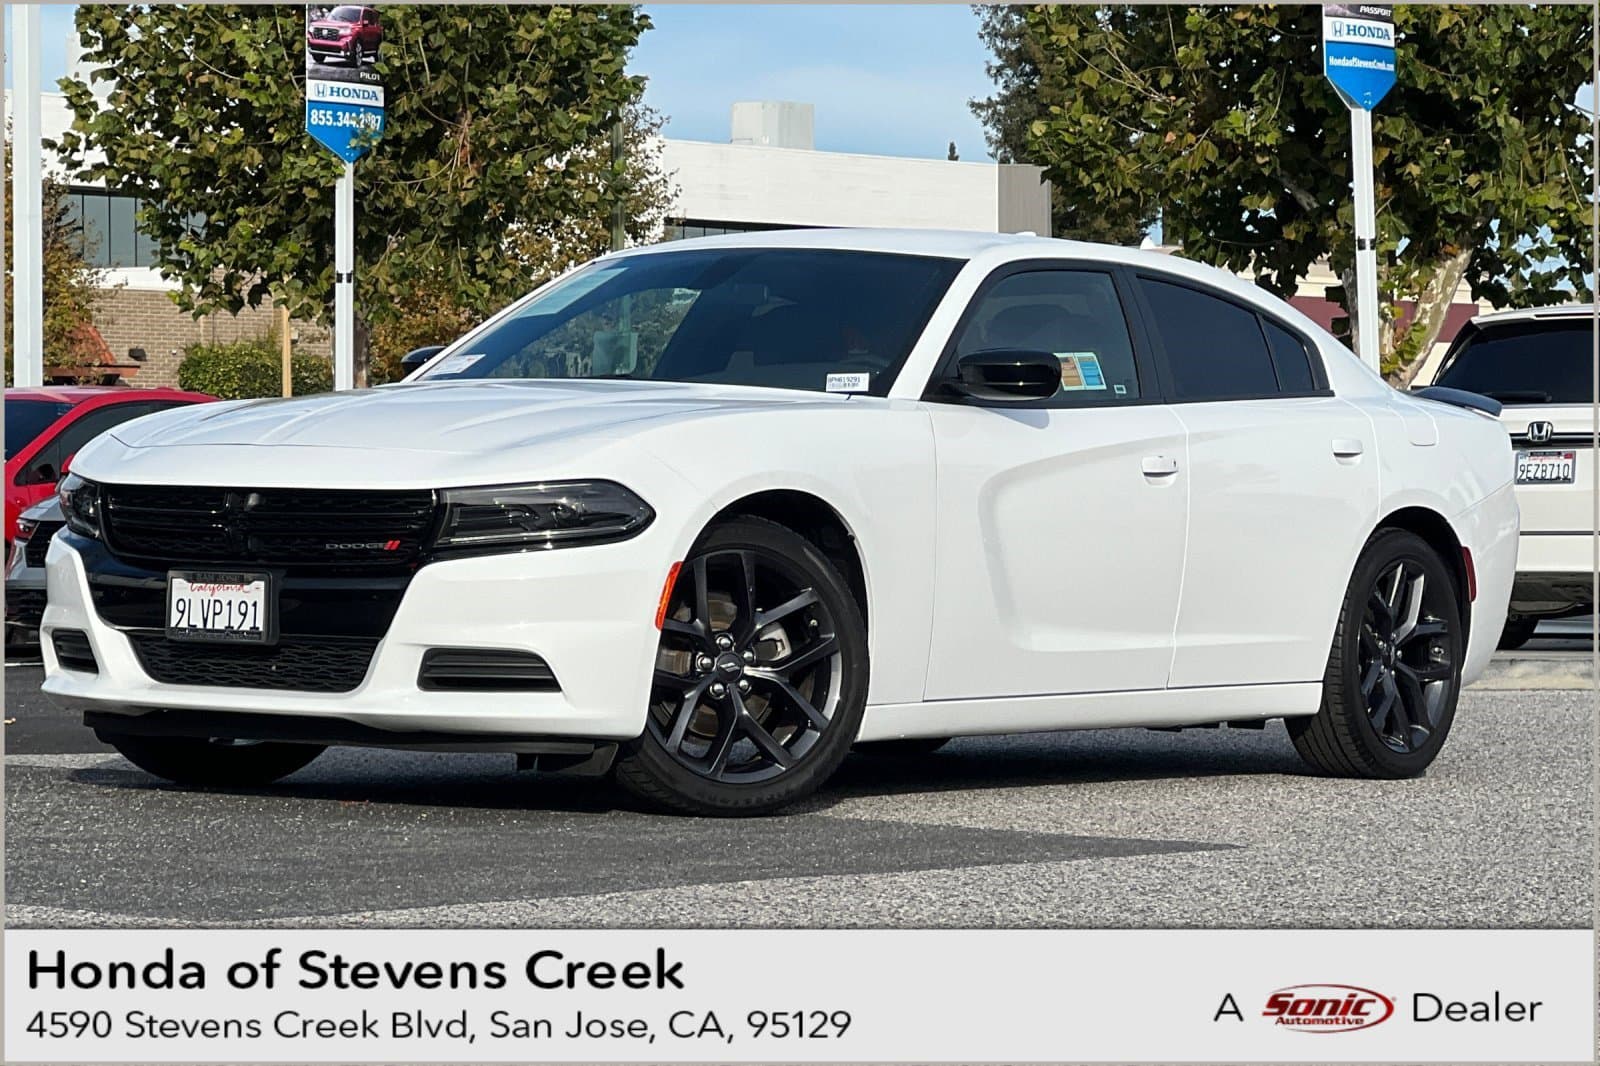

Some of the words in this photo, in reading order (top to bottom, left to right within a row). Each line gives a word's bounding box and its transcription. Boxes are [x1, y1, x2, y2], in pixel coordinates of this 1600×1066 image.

[1359, 6, 1392, 17] PASSPORT
[1345, 24, 1391, 40] HONDA
[329, 86, 379, 101] HONDA
[325, 542, 385, 550] DODGE
[175, 598, 261, 631] 9LVP191
